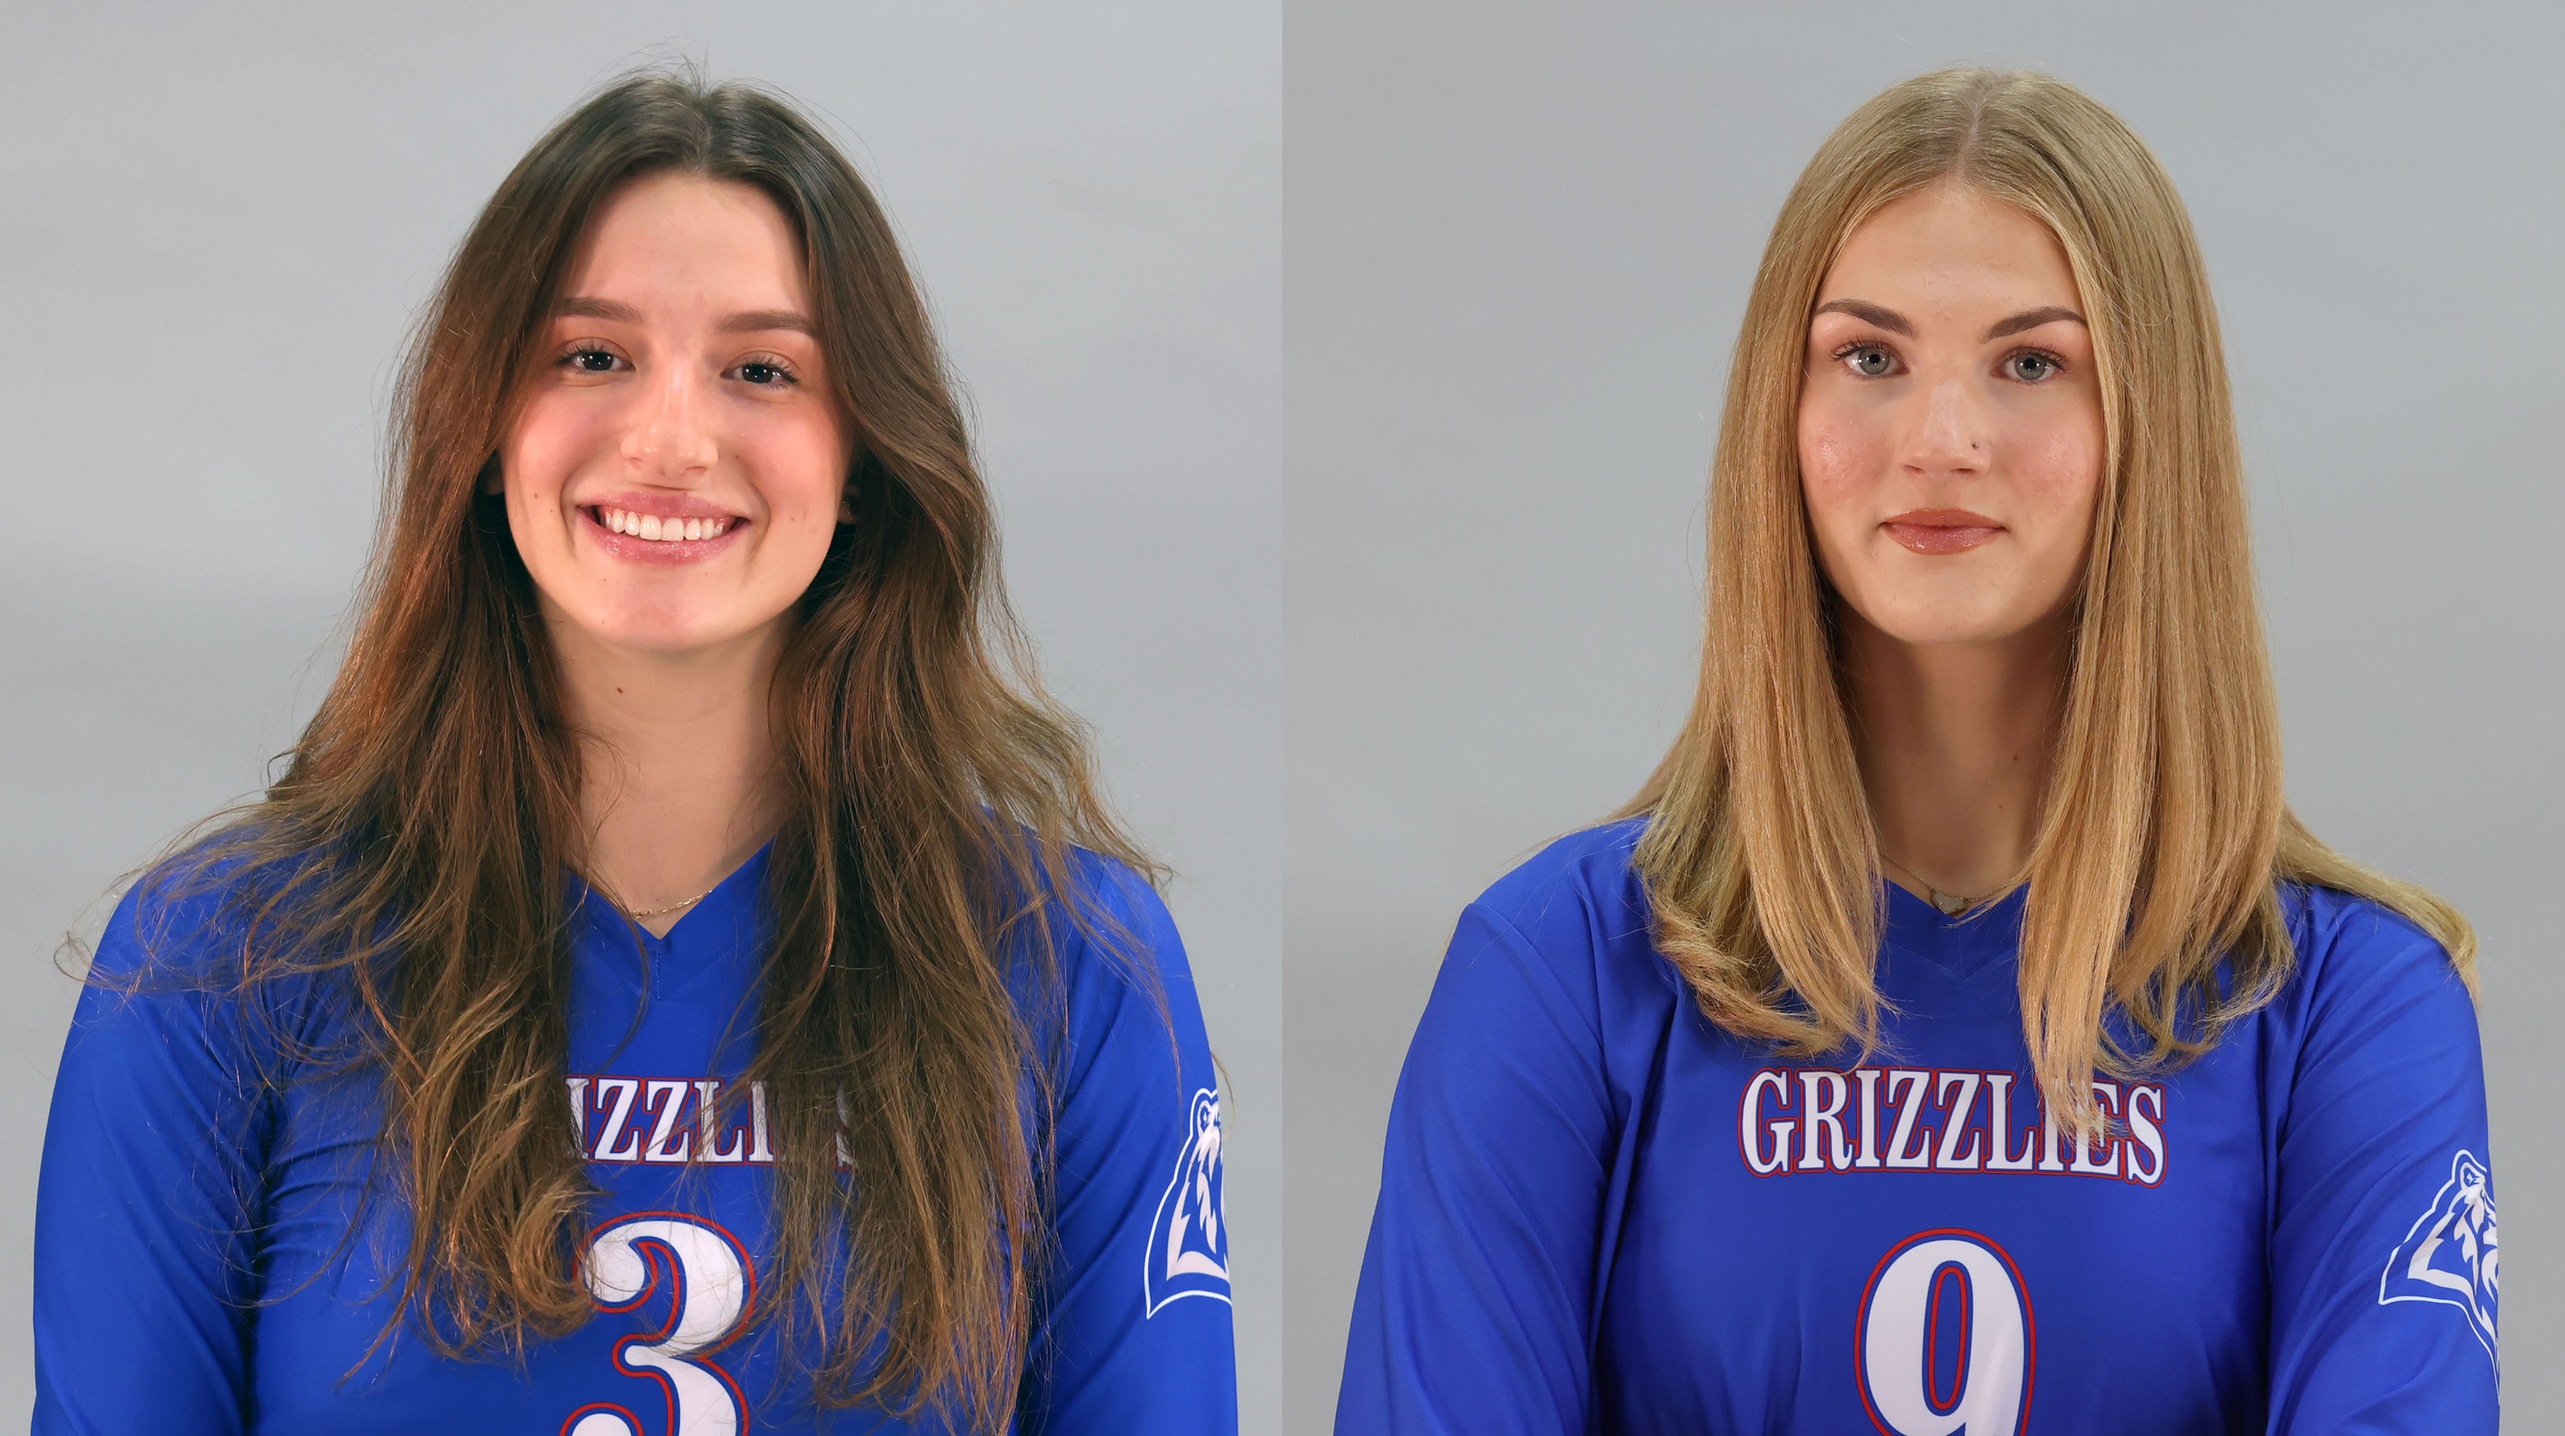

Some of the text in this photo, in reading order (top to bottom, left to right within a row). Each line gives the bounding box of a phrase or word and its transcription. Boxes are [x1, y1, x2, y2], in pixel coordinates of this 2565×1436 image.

[1738, 1067, 2168, 1188] GRIZZLIES
[560, 1211, 757, 1436] 3
[1854, 1228, 2036, 1436] 9
